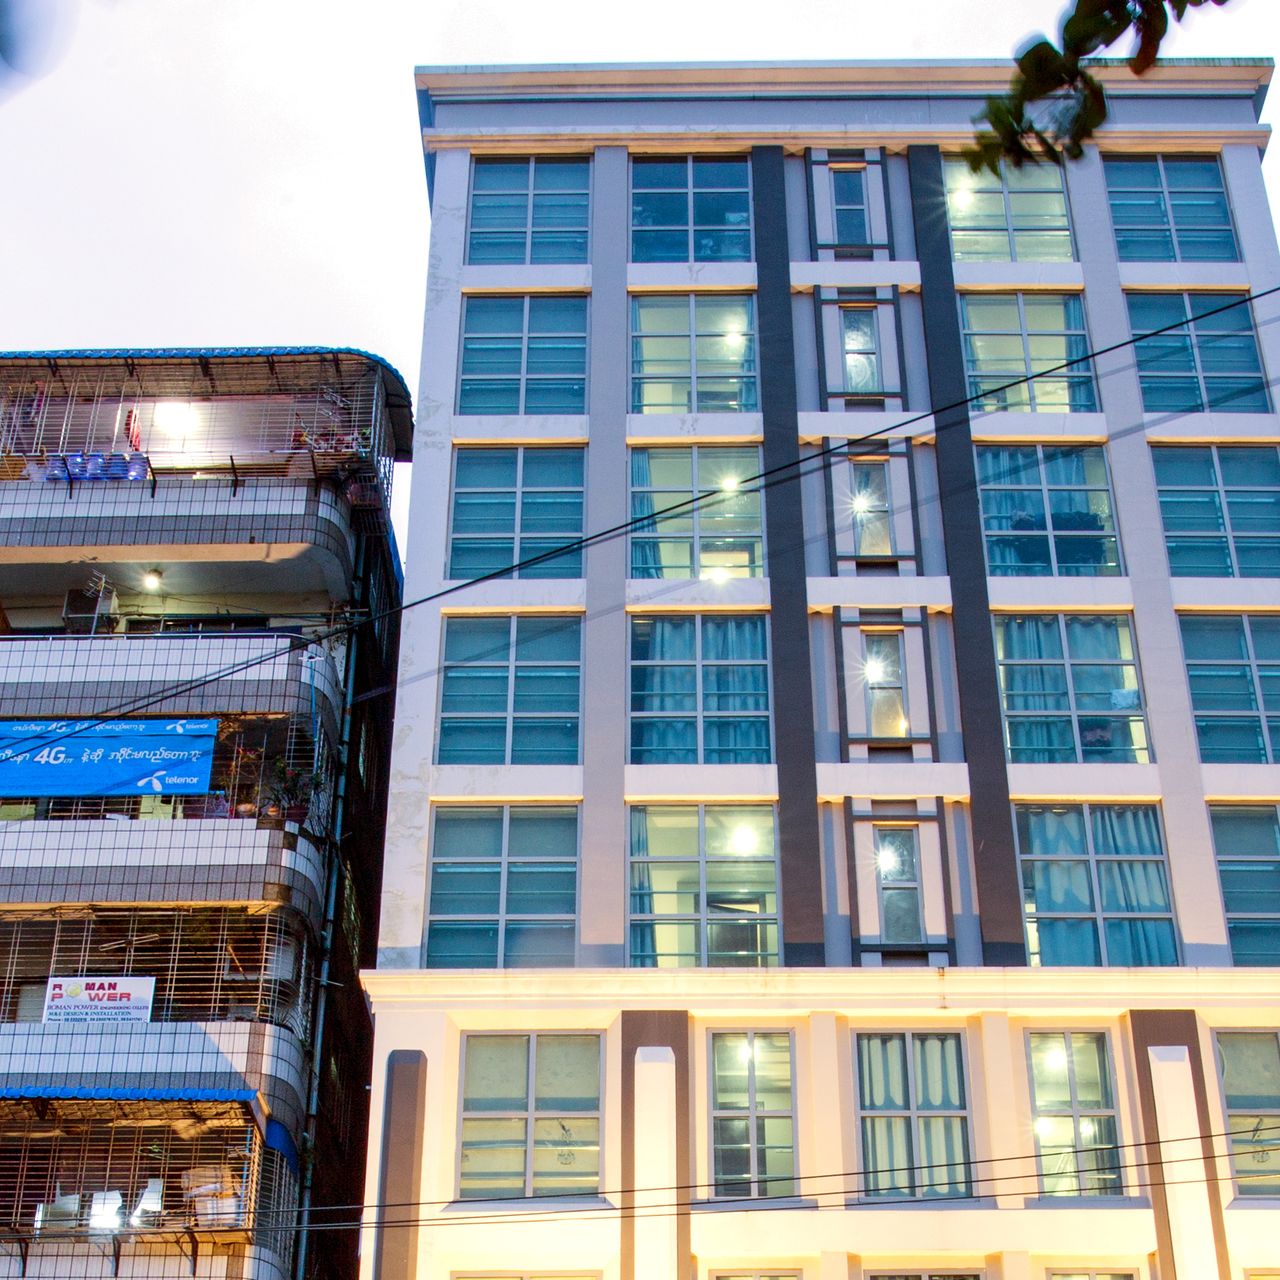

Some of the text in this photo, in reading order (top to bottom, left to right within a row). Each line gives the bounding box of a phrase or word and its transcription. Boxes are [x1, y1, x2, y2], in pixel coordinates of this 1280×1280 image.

[47, 722, 67, 732] 4G
[33, 746, 66, 765] 4G
[165, 774, 200, 784] telenor
